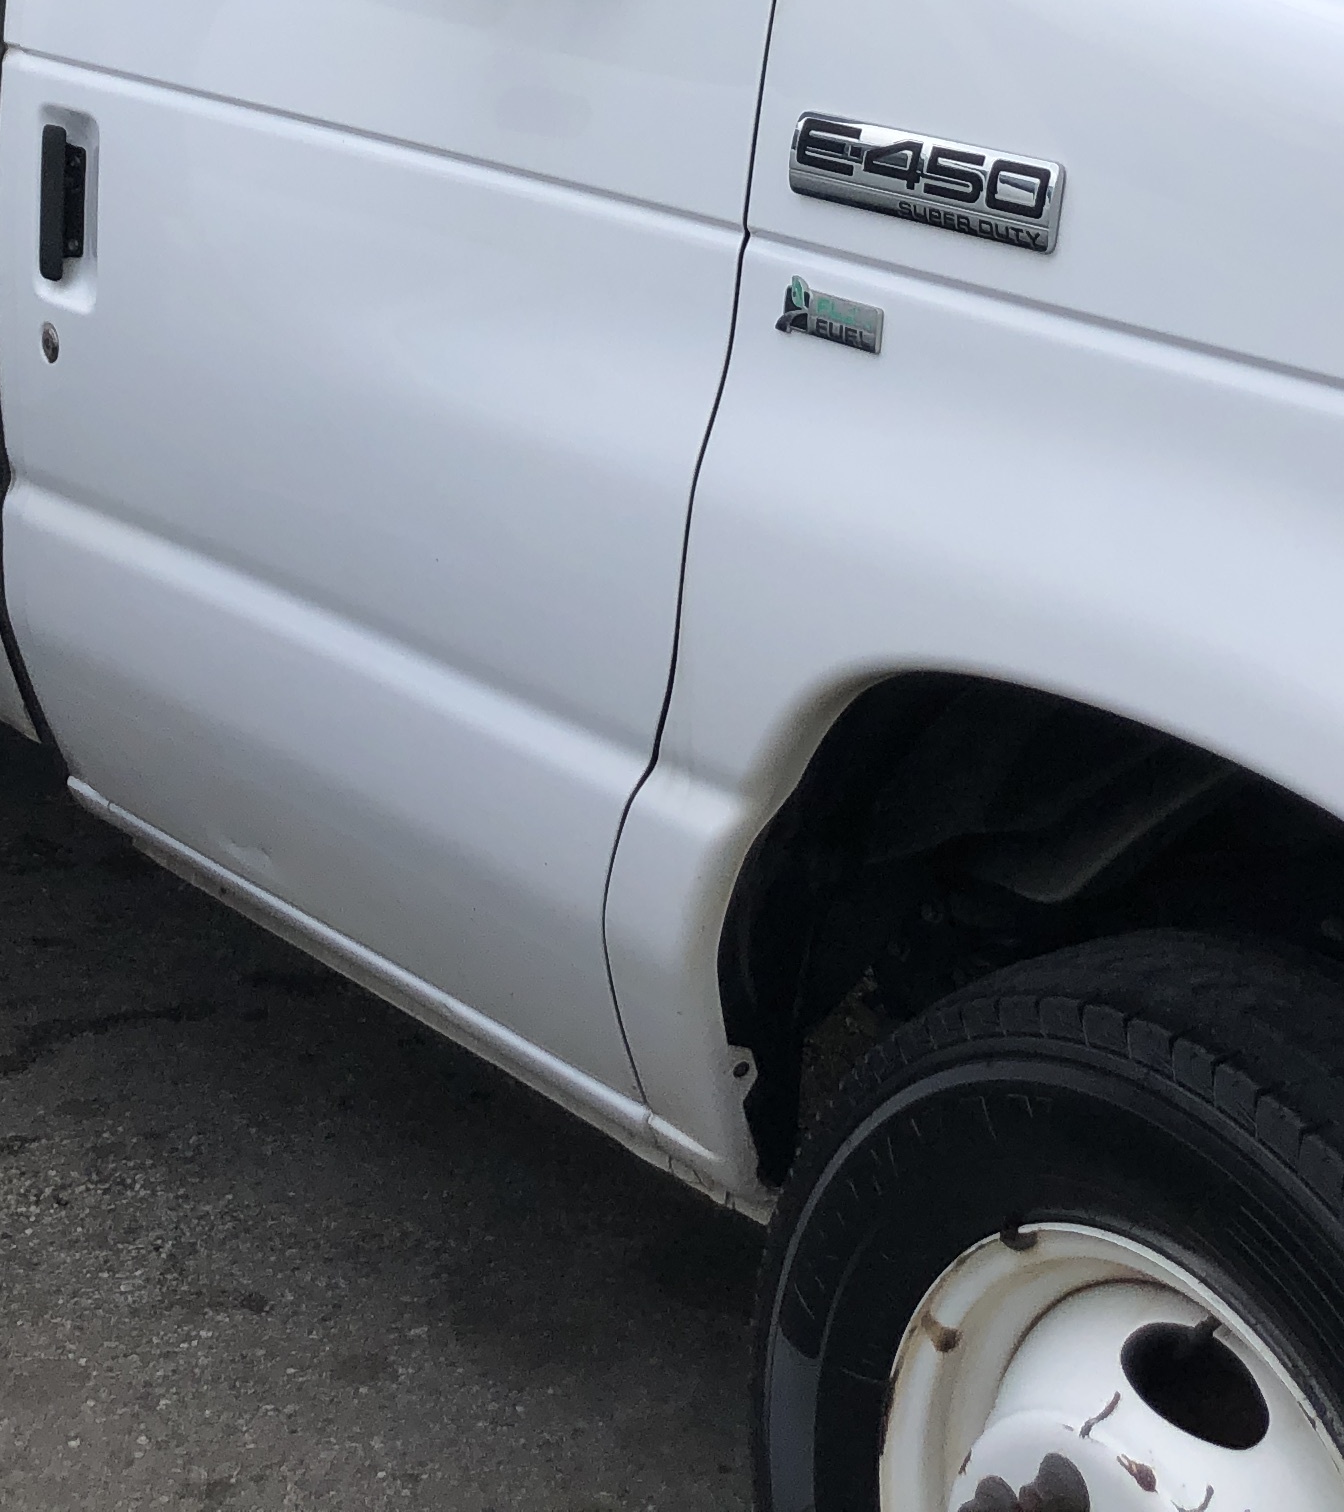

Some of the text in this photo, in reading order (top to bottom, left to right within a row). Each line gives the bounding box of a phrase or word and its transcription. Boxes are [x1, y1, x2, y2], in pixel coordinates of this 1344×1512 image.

[796, 117, 1052, 220] E-450
[897, 199, 1043, 248] SUPER DUTY
